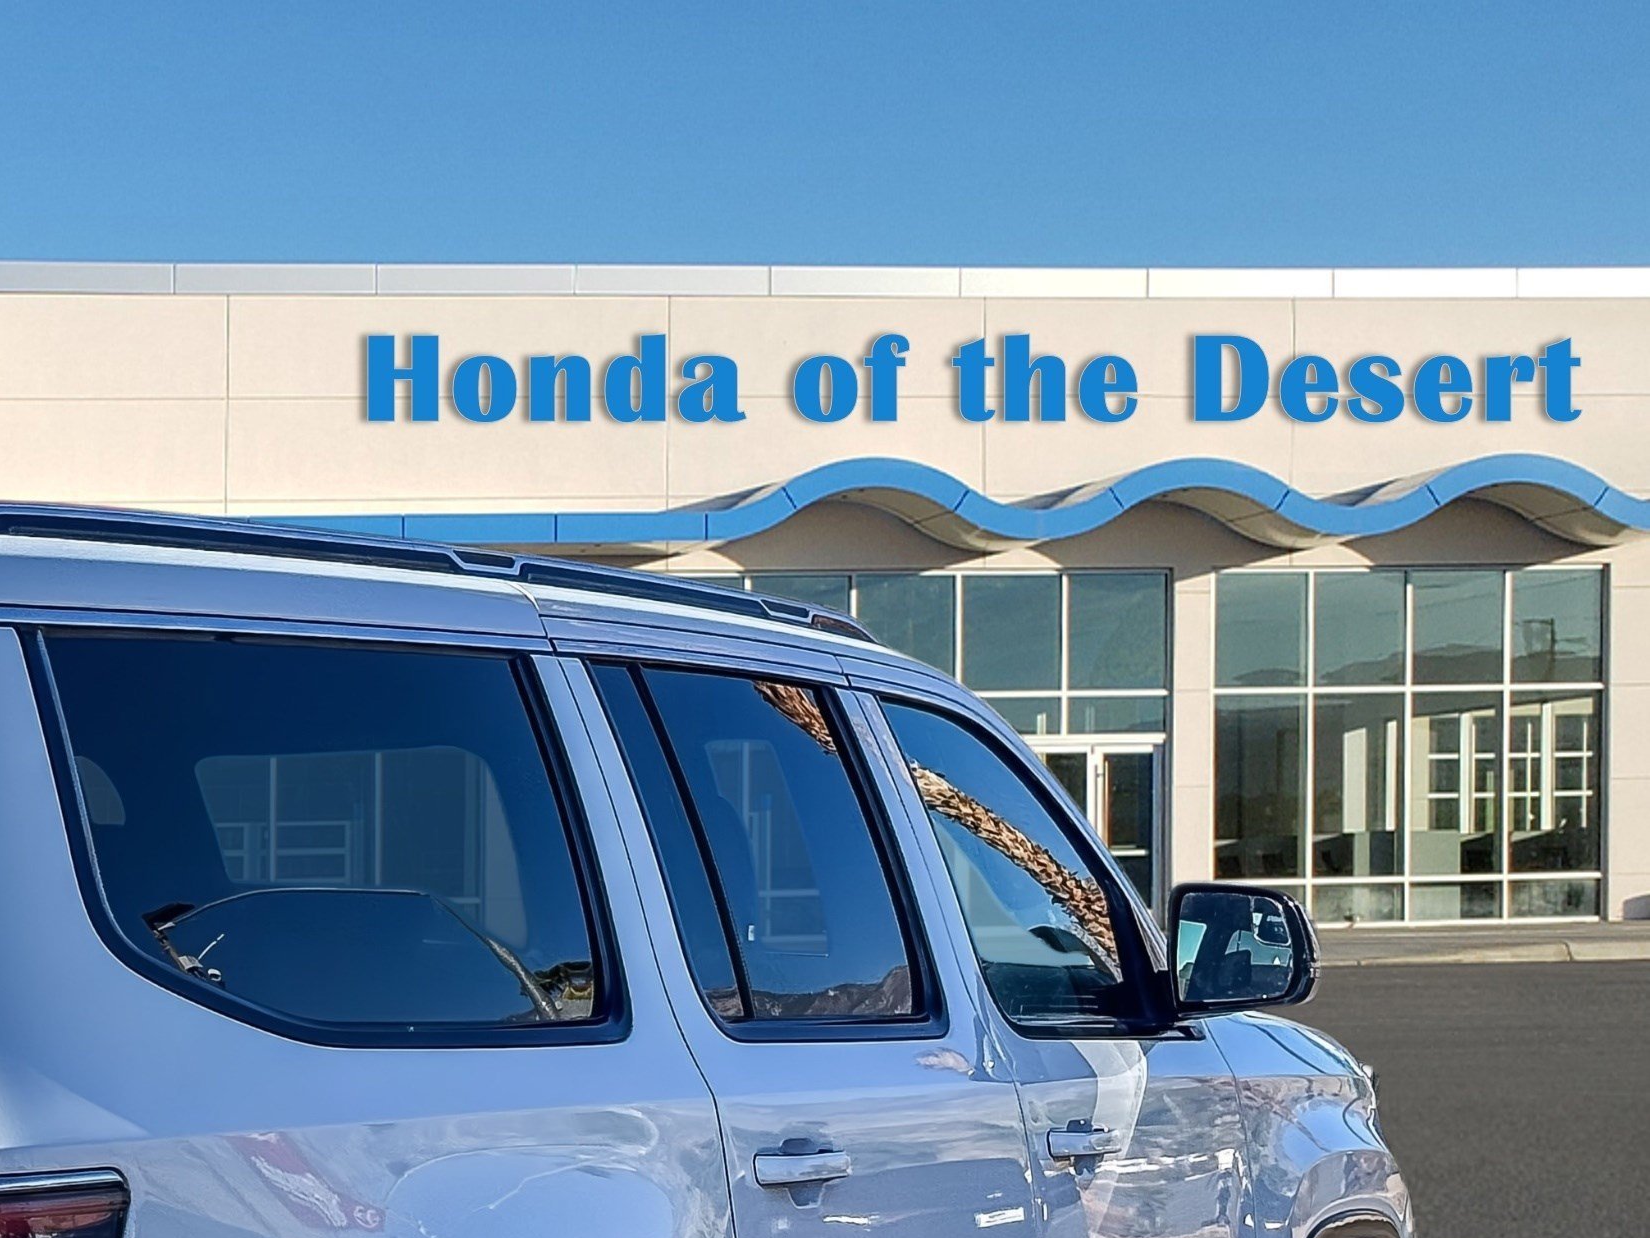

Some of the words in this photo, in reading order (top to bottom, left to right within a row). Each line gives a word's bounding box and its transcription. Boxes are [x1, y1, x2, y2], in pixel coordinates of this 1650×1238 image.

[364, 333, 747, 425] Honda
[792, 333, 911, 424] of
[950, 333, 1139, 424] the
[1193, 334, 1583, 424] Desert
